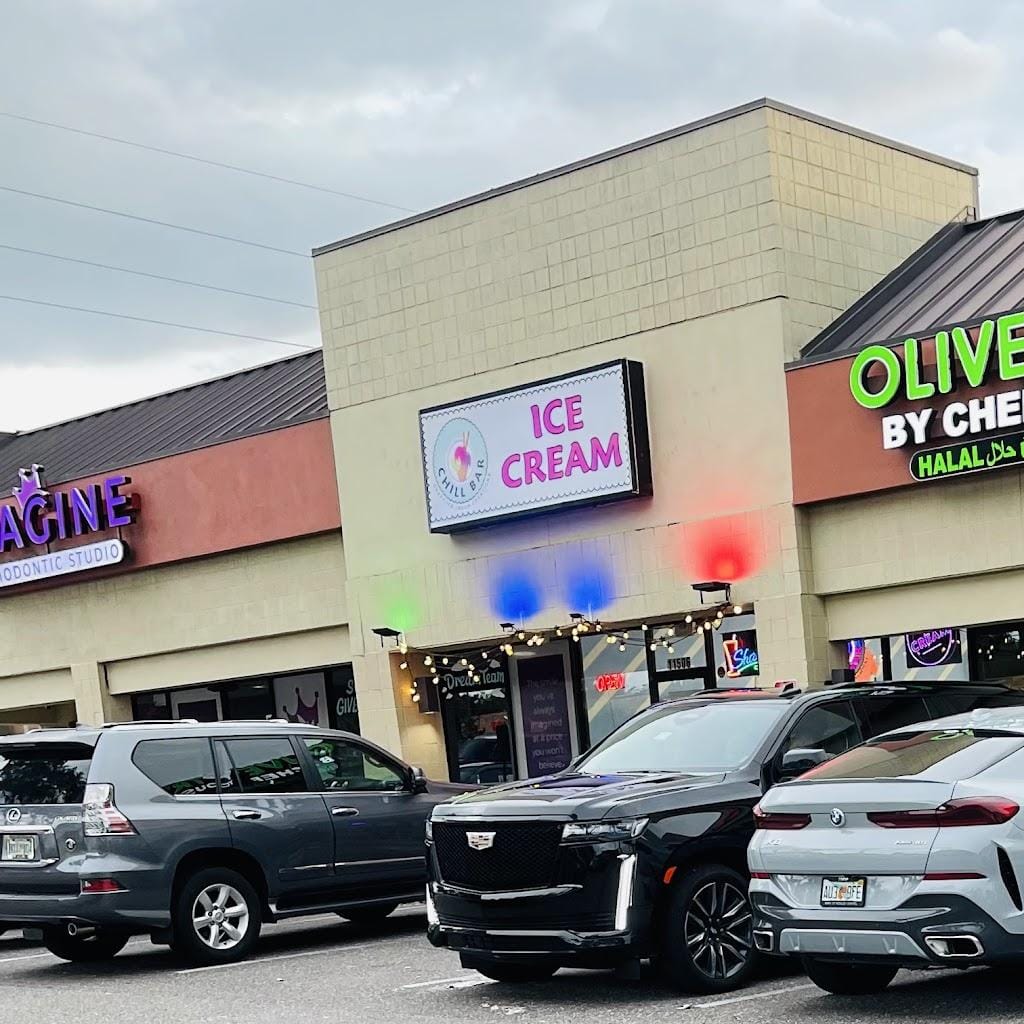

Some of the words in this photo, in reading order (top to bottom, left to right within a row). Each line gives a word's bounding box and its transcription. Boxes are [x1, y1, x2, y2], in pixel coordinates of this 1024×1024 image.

[530, 394, 584, 439] ICE
[882, 408, 939, 450] BY
[501, 432, 624, 489] CREAM
[918, 445, 985, 478] HALAL
[986, 439, 1016, 467] حلال
[438, 467, 466, 498] CHILL
[469, 459, 485, 491] BAR
[0, 556, 62, 581] ODONTIC
[68, 543, 119, 568] STUDIO
[479, 667, 505, 684] Team
[595, 672, 626, 692] OPEN
